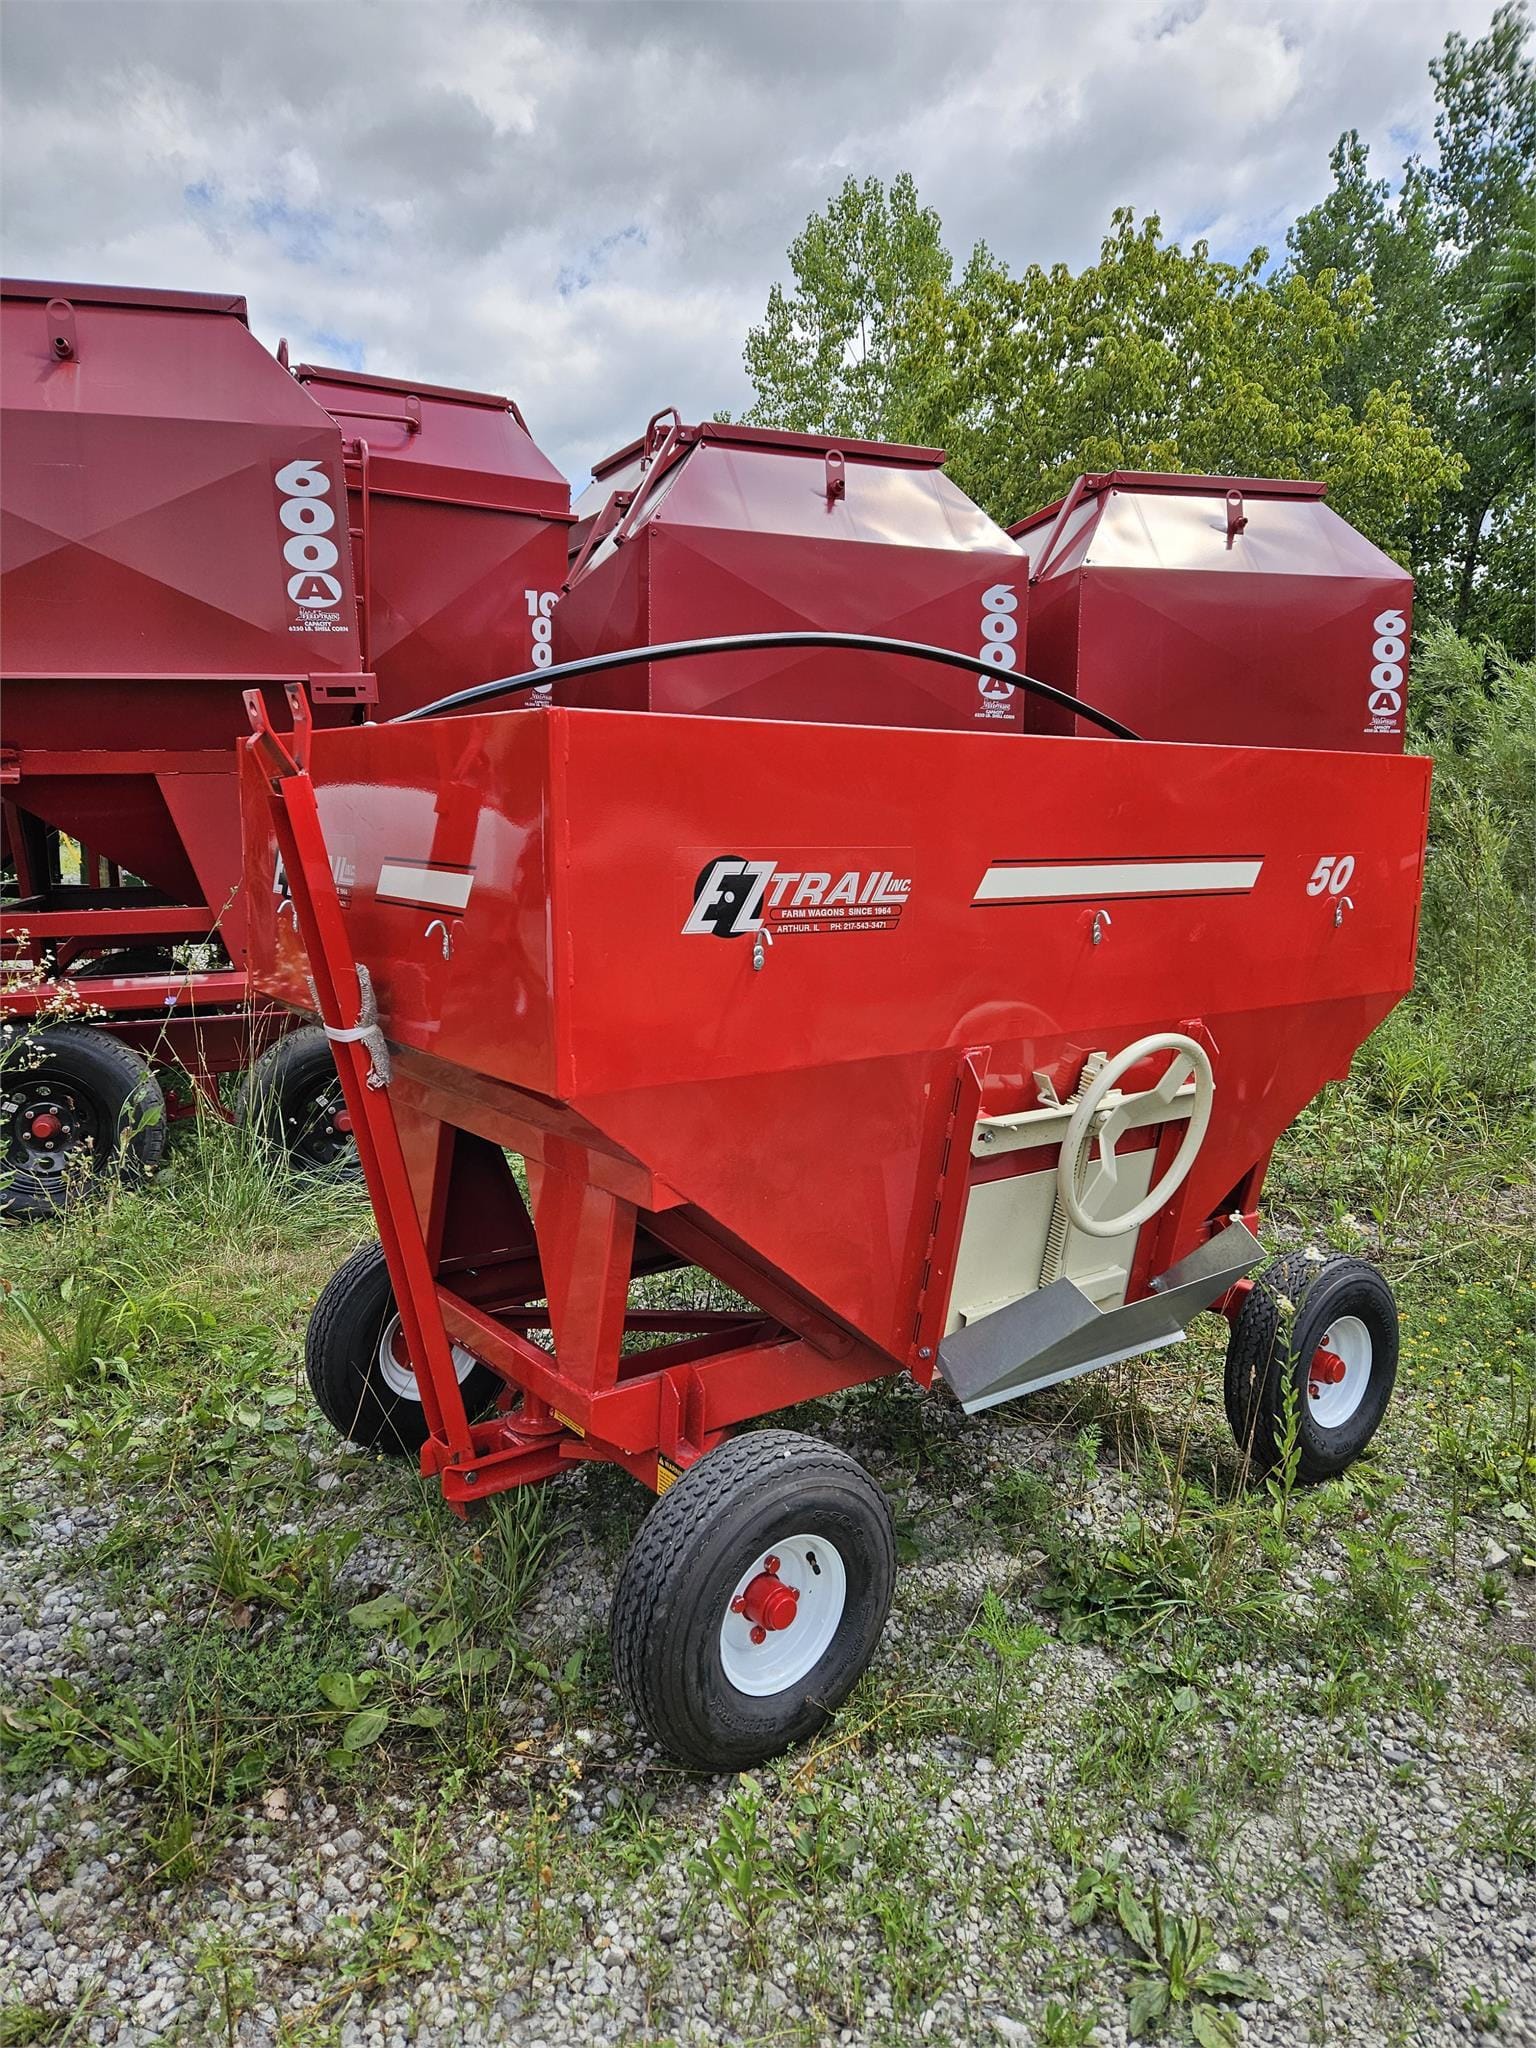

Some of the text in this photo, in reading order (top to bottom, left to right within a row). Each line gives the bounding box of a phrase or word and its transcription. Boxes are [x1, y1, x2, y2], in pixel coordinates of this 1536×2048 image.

[275, 460, 342, 608] 600A
[978, 584, 1018, 700] 600A
[1368, 609, 1406, 716] 600A
[768, 872, 909, 906] TRAIL
[886, 879, 912, 892] INC.
[1306, 855, 1355, 897] 50
[781, 907, 891, 918] FARM WAGONS SINCE 1964
[813, 924, 820, 932] IL
[830, 923, 842, 931] PH:
[843, 921, 887, 931] 217-543-3471
